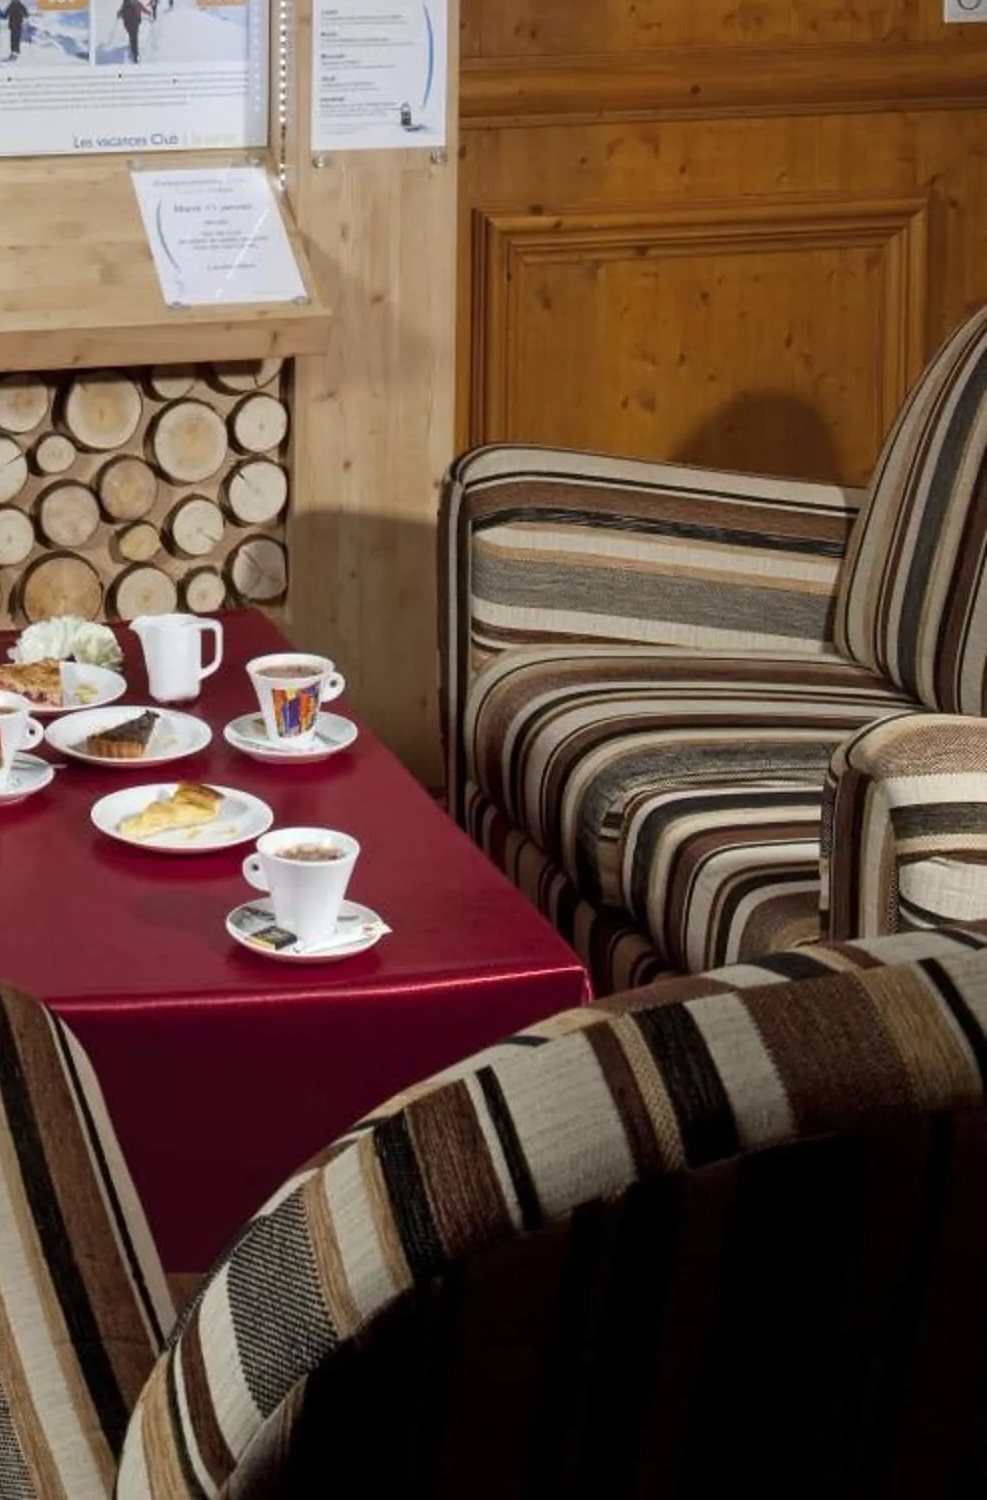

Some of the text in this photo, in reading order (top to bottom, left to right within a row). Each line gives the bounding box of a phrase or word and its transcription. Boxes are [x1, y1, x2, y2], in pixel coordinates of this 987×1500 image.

[73, 135, 93, 148] Les
[96, 134, 147, 148] vacances
[150, 133, 180, 146] Club
